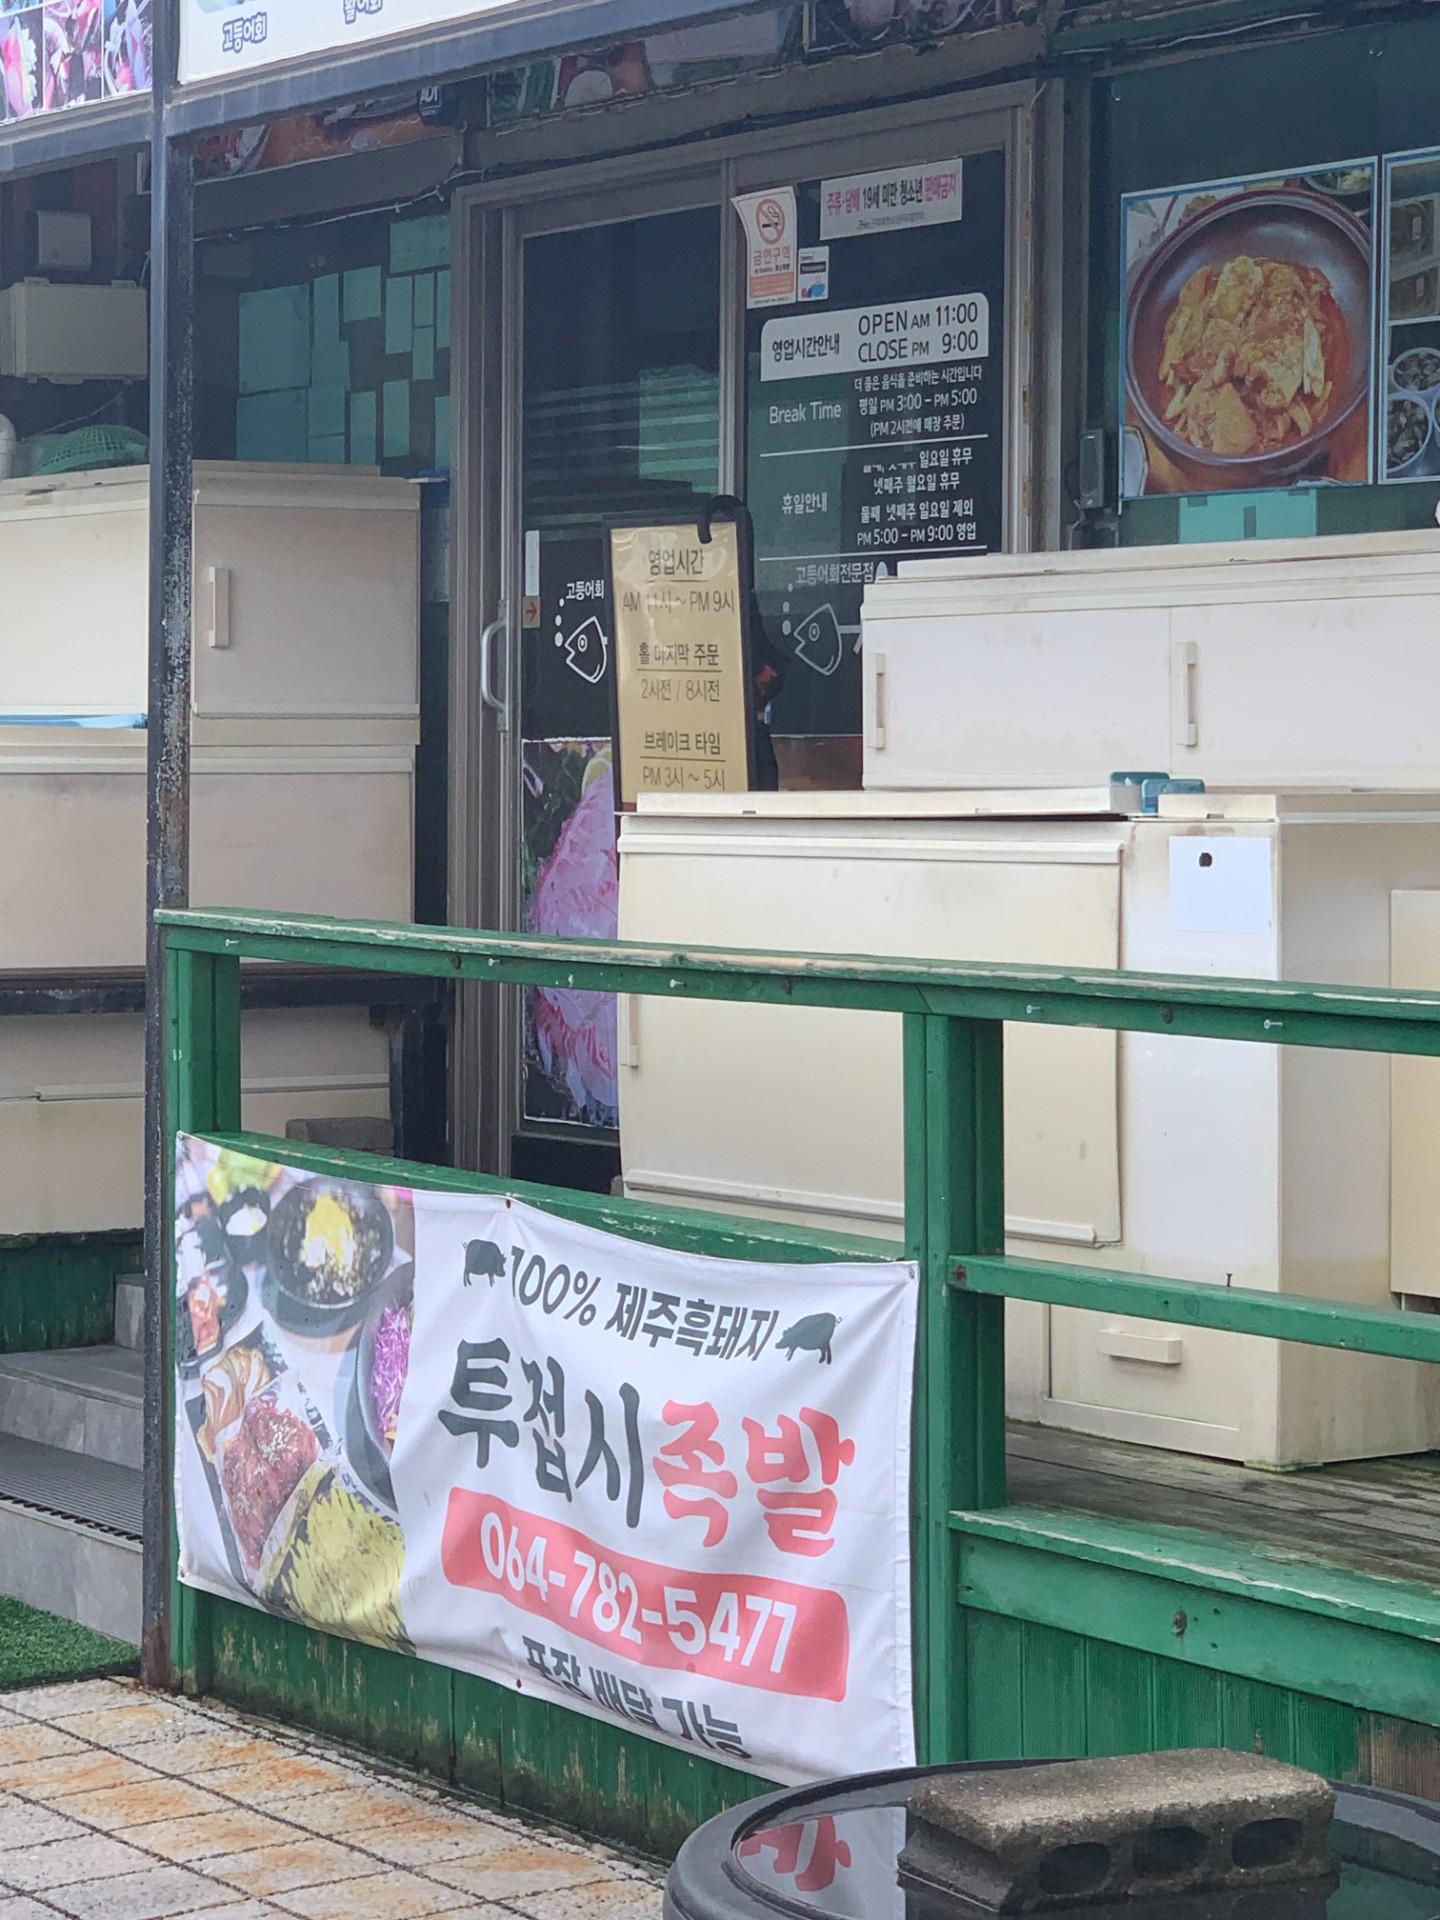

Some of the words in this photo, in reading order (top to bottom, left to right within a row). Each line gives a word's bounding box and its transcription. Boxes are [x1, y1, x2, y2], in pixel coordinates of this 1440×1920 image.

[222, 12, 267, 53] 고등어회
[863, 184, 879, 209] 19세
[882, 182, 898, 208] 미만
[900, 176, 923, 206] 청소년
[753, 245, 792, 266] 금연구역
[858, 311, 908, 336] OPEN
[911, 313, 930, 330] AM
[935, 302, 978, 327] 11:00
[772, 333, 840, 363] 영업시간안내
[858, 338, 908, 363] CLOSE
[912, 341, 929, 357] PM
[942, 330, 979, 354] 9:00
[854, 378, 862, 392] 더
[864, 376, 880, 392] 좋은
[882, 372, 905, 390] 음식을
[907, 369, 939, 387] 준비하는
[941, 365, 983, 383] 시간입니다
[769, 403, 807, 424] Break
[809, 401, 842, 420] Time
[859, 397, 878, 415] 평일
[880, 399, 895, 412] PM
[897, 393, 922, 411] 3:00
[934, 394, 949, 407] PM
[951, 388, 978, 406] 5:00
[870, 421, 889, 438] (PM
[943, 413, 965, 430] 주문)
[920, 449, 949, 469] 일요일
[952, 447, 973, 466] 휴무
[906, 473, 937, 493] 월요일
[940, 471, 960, 490] 휴무
[782, 492, 828, 515] 휴일안내
[860, 505, 880, 524] 둘째
[886, 503, 916, 521] 넷째주
[920, 500, 950, 520] 일요일
[953, 498, 973, 517] 제외
[857, 532, 872, 545] PM
[873, 527, 899, 545] 5:00
[910, 529, 925, 542] PM
[927, 524, 954, 542] 9:00
[956, 522, 976, 541] 영업
[648, 549, 704, 576] 영업시간
[795, 562, 874, 585] 고등어회전문점
[566, 579, 604, 600] 고등어회
[623, 591, 640, 612] AM
[690, 591, 710, 612] PM
[712, 589, 735, 614] 9시
[639, 642, 650, 665] 홀
[654, 643, 689, 666] 마지막
[693, 644, 719, 666] 주문
[641, 679, 671, 701] 2시전
[686, 679, 720, 702] 8시전
[644, 731, 690, 752] 브레이크
[695, 732, 721, 755] 타임
[643, 766, 661, 786] PM
[665, 767, 684, 789] 3시
[704, 769, 726, 790] 5시
[511, 1245, 602, 1327] 100%
[604, 1282, 780, 1361] 제주흑돼지
[480, 1511, 797, 1674] 064-782-5477
[522, 1635, 593, 1700] 포장
[588, 1666, 663, 1733] 배달
[661, 1696, 752, 1759] 가능
